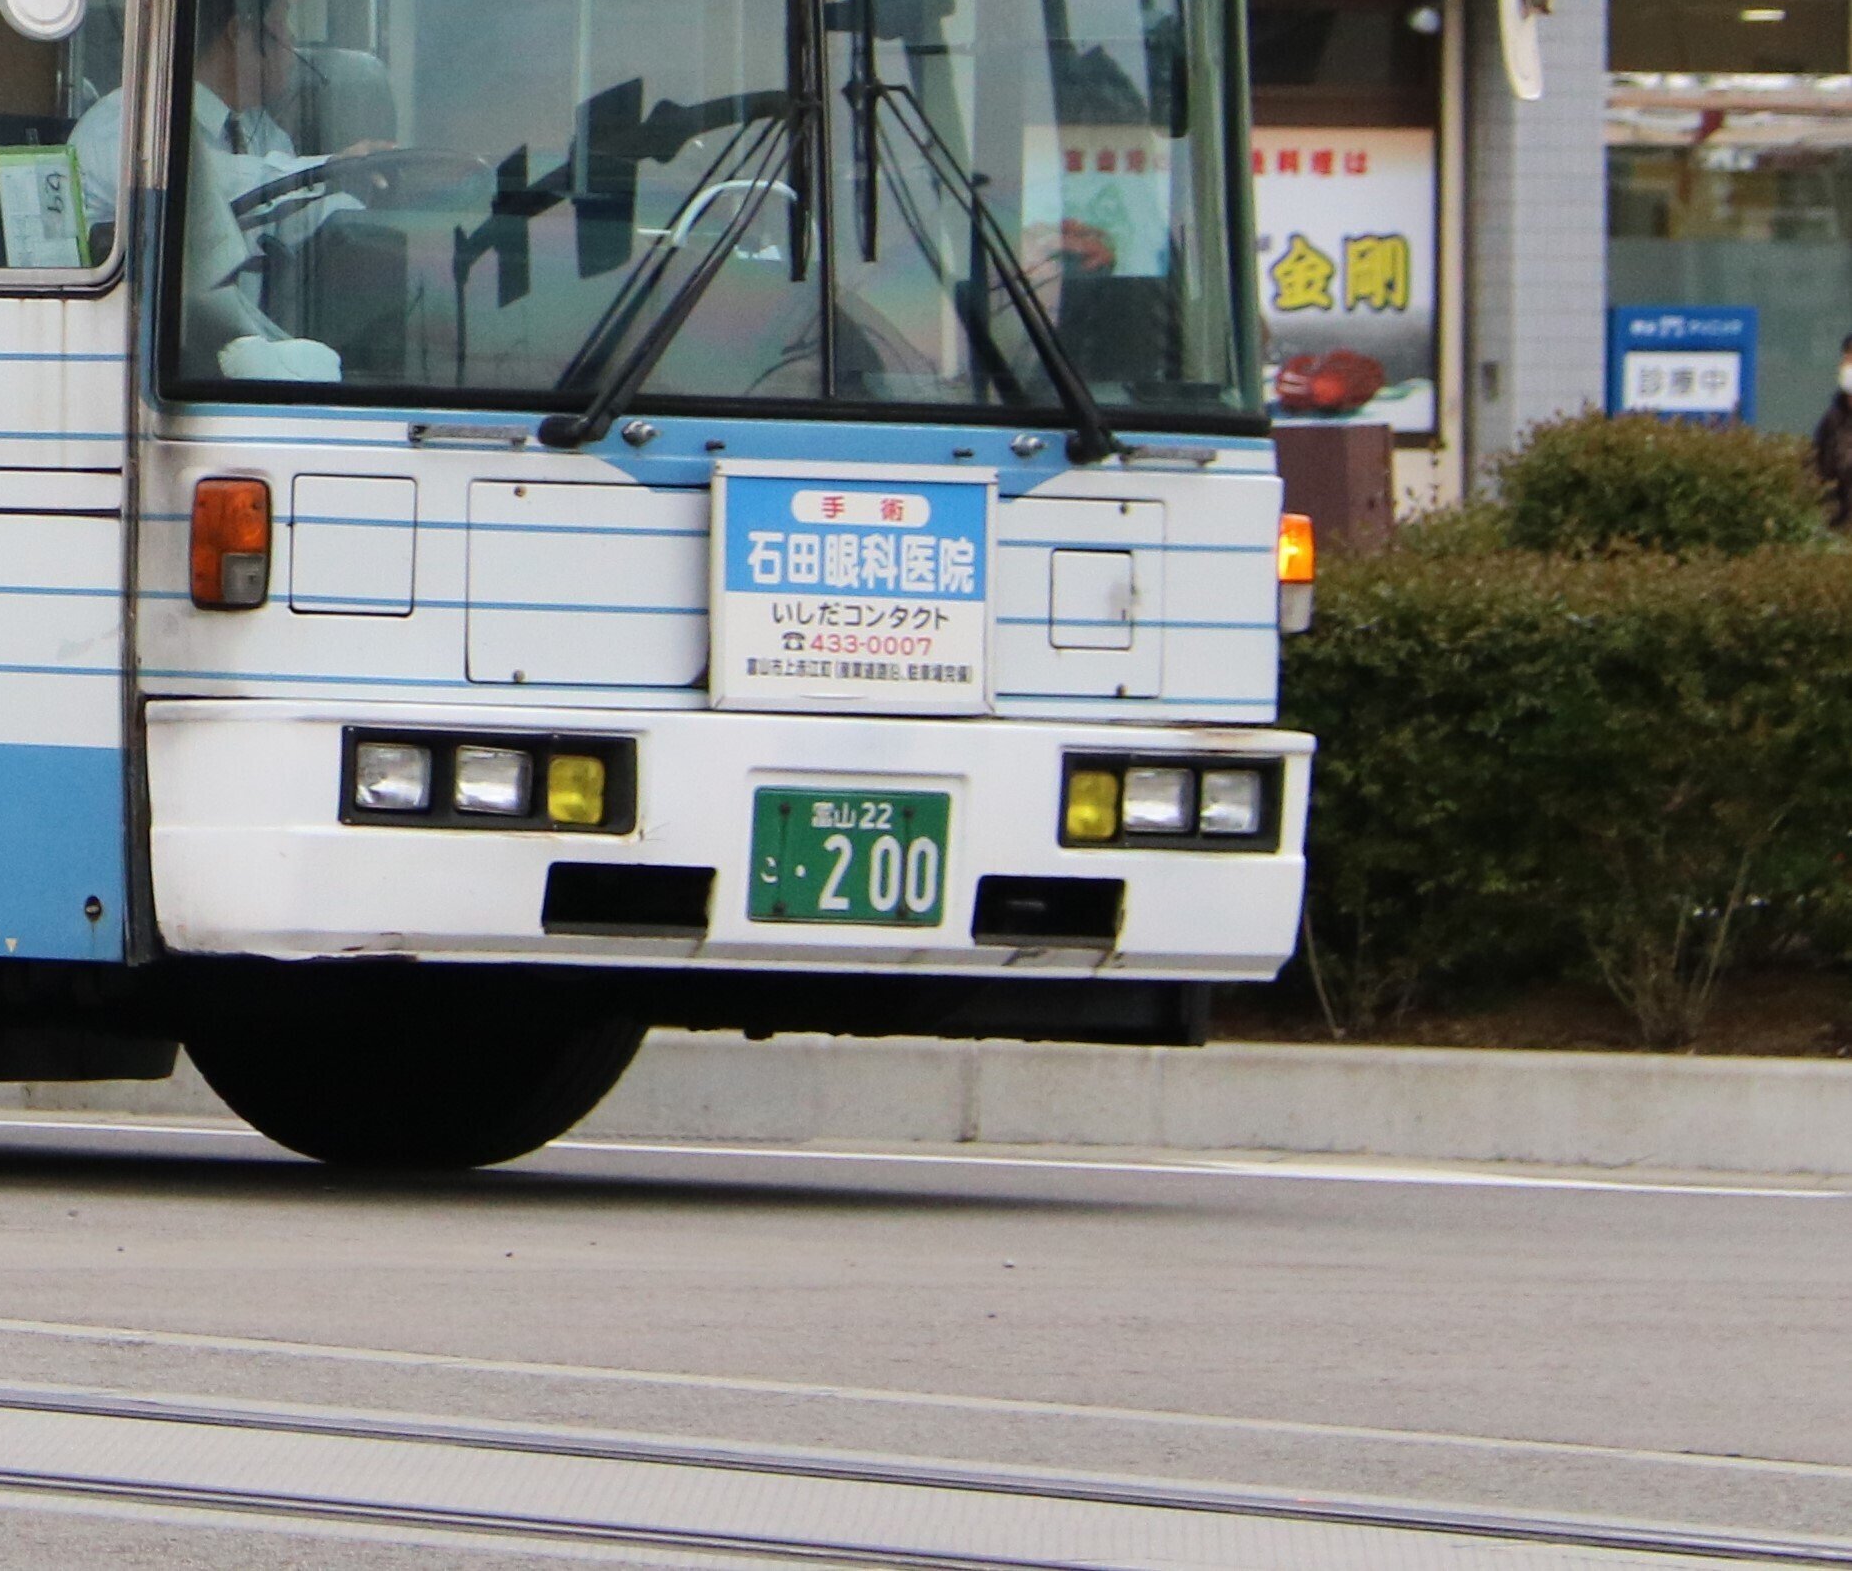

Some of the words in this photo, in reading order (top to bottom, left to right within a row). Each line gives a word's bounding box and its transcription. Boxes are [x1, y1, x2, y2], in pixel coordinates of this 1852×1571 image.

[1272, 231, 1409, 312] 金剛
[821, 495, 905, 522] 手術
[747, 530, 976, 594] 石田眼科医院
[772, 601, 950, 630] いしだコンタクト
[810, 634, 933, 657] 433-0007
